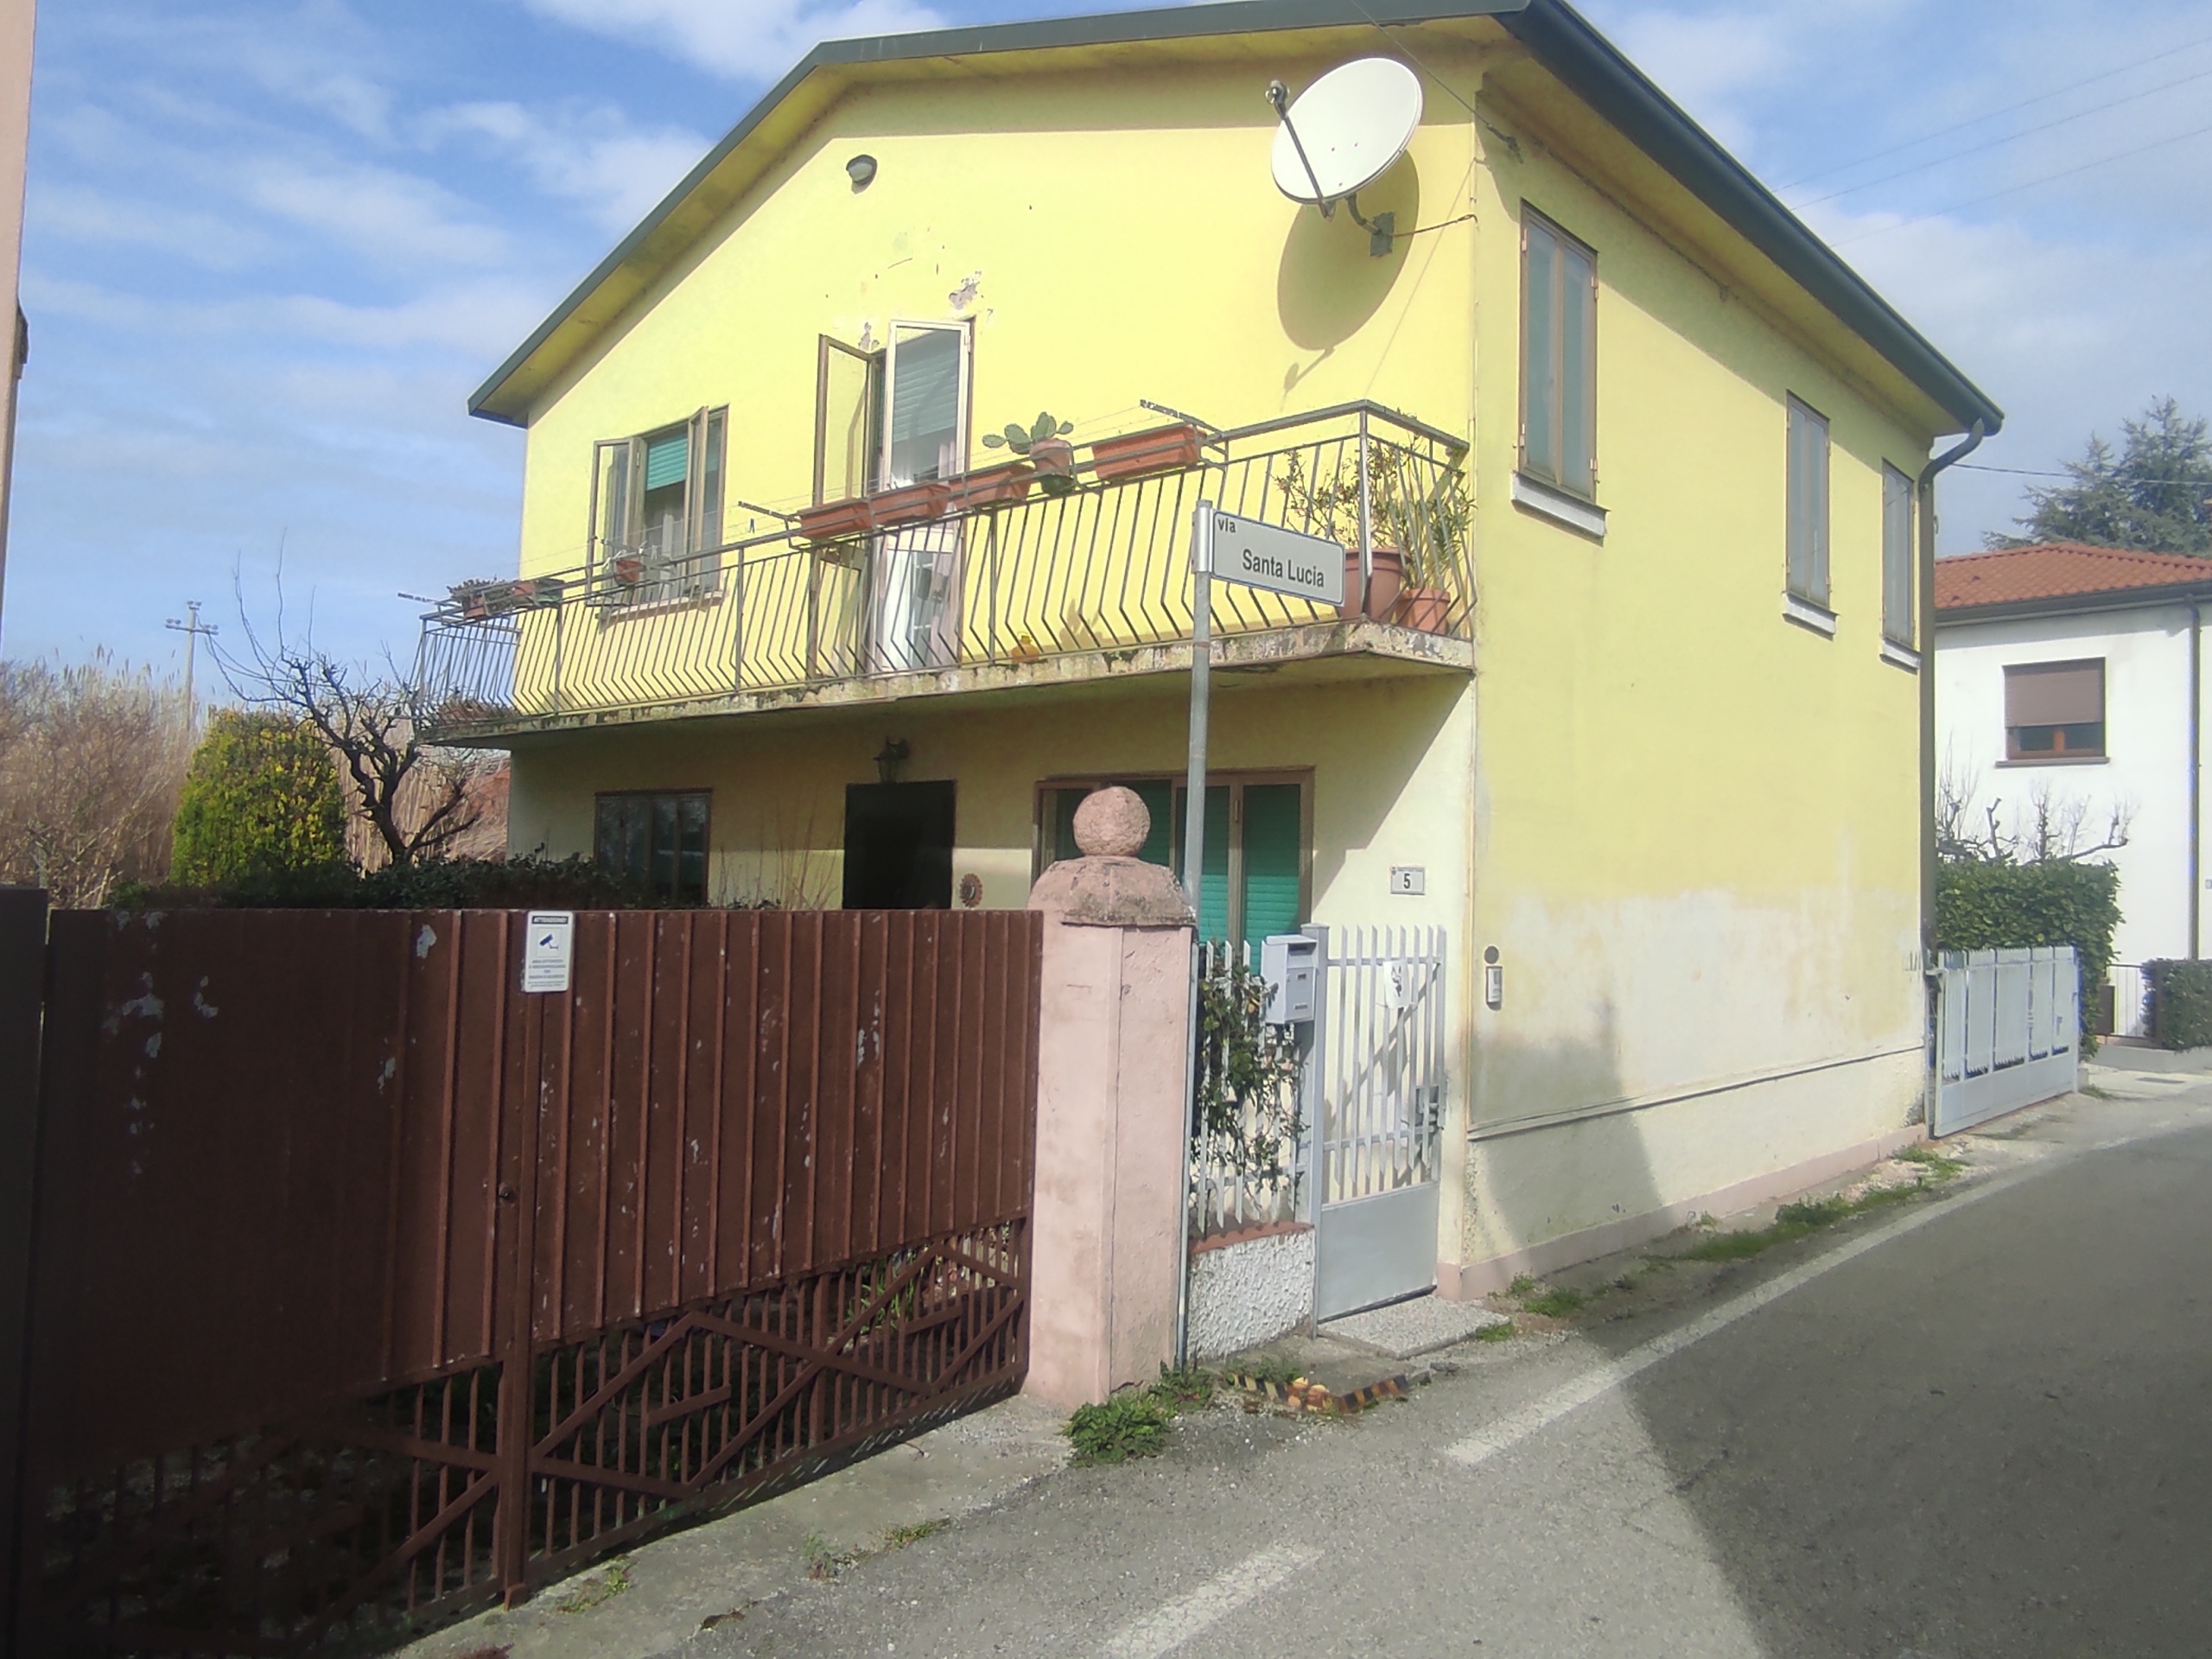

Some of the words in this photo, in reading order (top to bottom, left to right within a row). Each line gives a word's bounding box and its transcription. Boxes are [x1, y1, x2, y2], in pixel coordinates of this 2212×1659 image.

[1217, 518, 1236, 533] via
[1243, 549, 1283, 578] Santa
[1287, 559, 1325, 588] Lucia
[1403, 873, 1411, 889] 5
